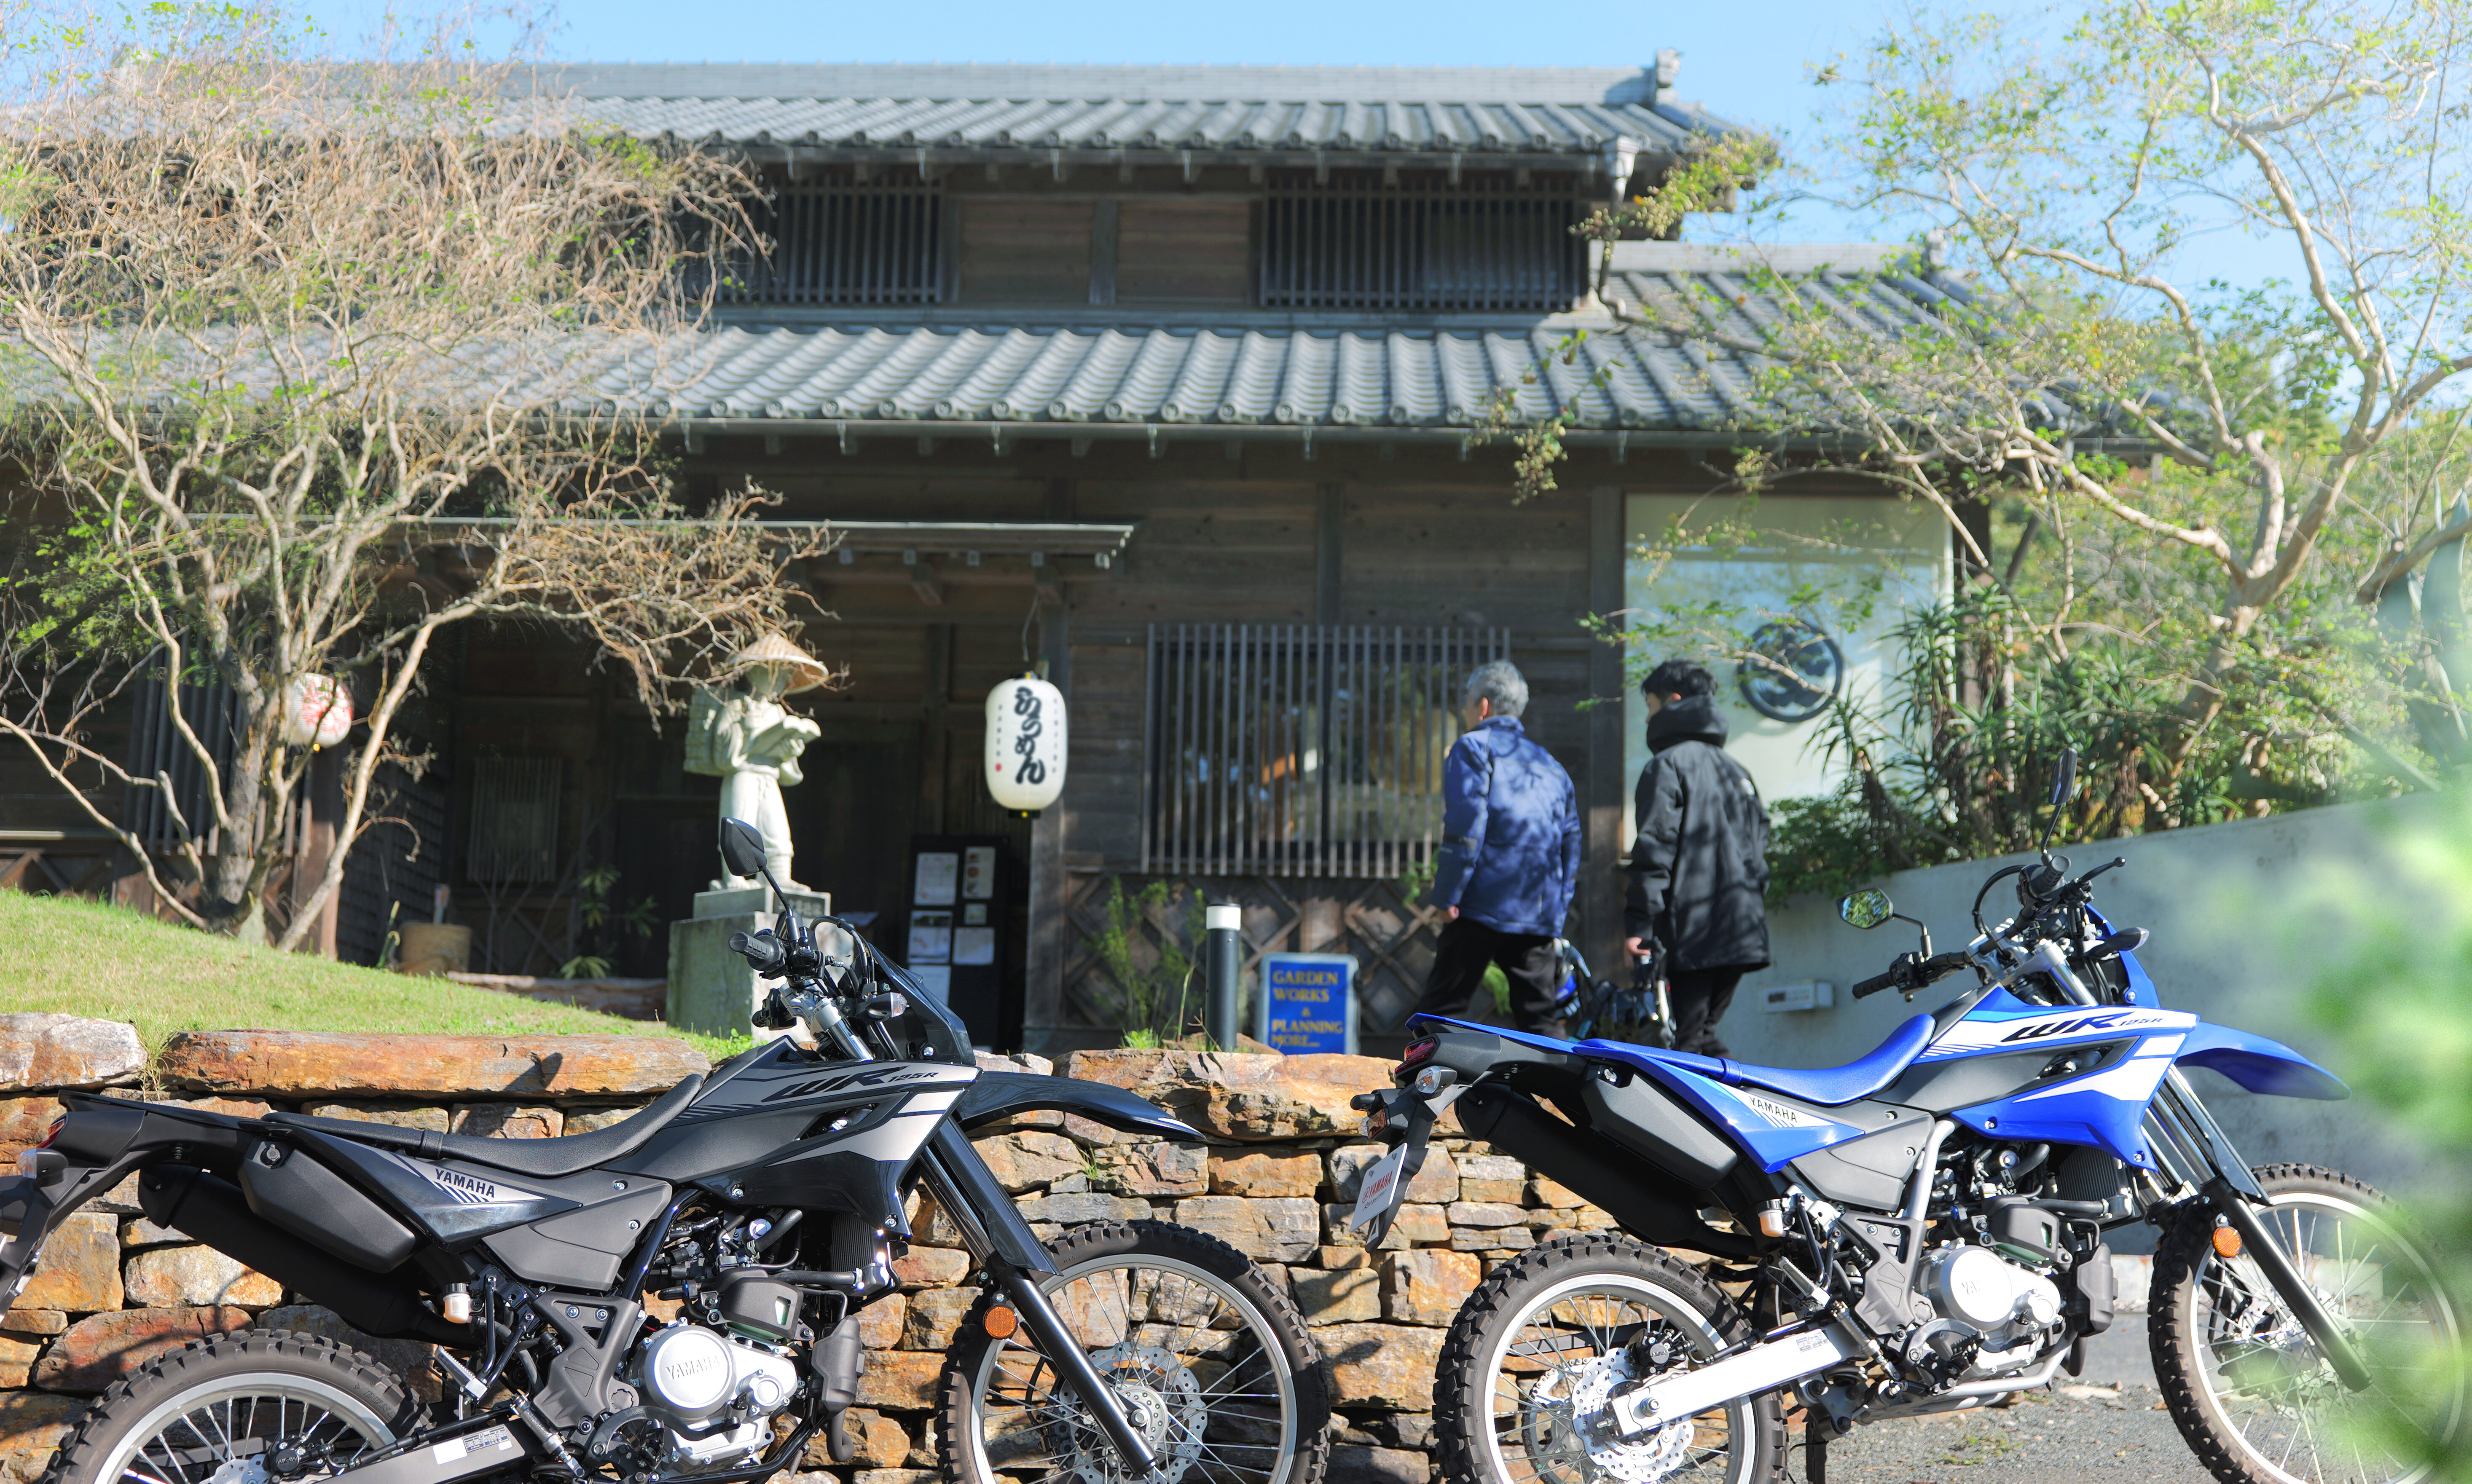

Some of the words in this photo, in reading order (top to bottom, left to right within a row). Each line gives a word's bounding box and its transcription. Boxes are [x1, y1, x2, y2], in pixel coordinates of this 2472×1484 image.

[1272, 970, 1338, 986] GARDEN
[1273, 988, 1330, 1002] WORKS
[1271, 1018, 1344, 1034] PLANNING
[2118, 1017, 2163, 1027] 125R
[761, 1065, 910, 1103] WR
[887, 1071, 939, 1083] 125R
[1749, 1095, 1798, 1123] YAMAHA
[435, 1168, 495, 1198] YAMAHA
[1369, 1170, 1393, 1199] YAMAHA
[1648, 1269, 1697, 1296] DUNLOP
[666, 1355, 721, 1380] YAMAHA
[363, 1390, 396, 1420] DUNL
